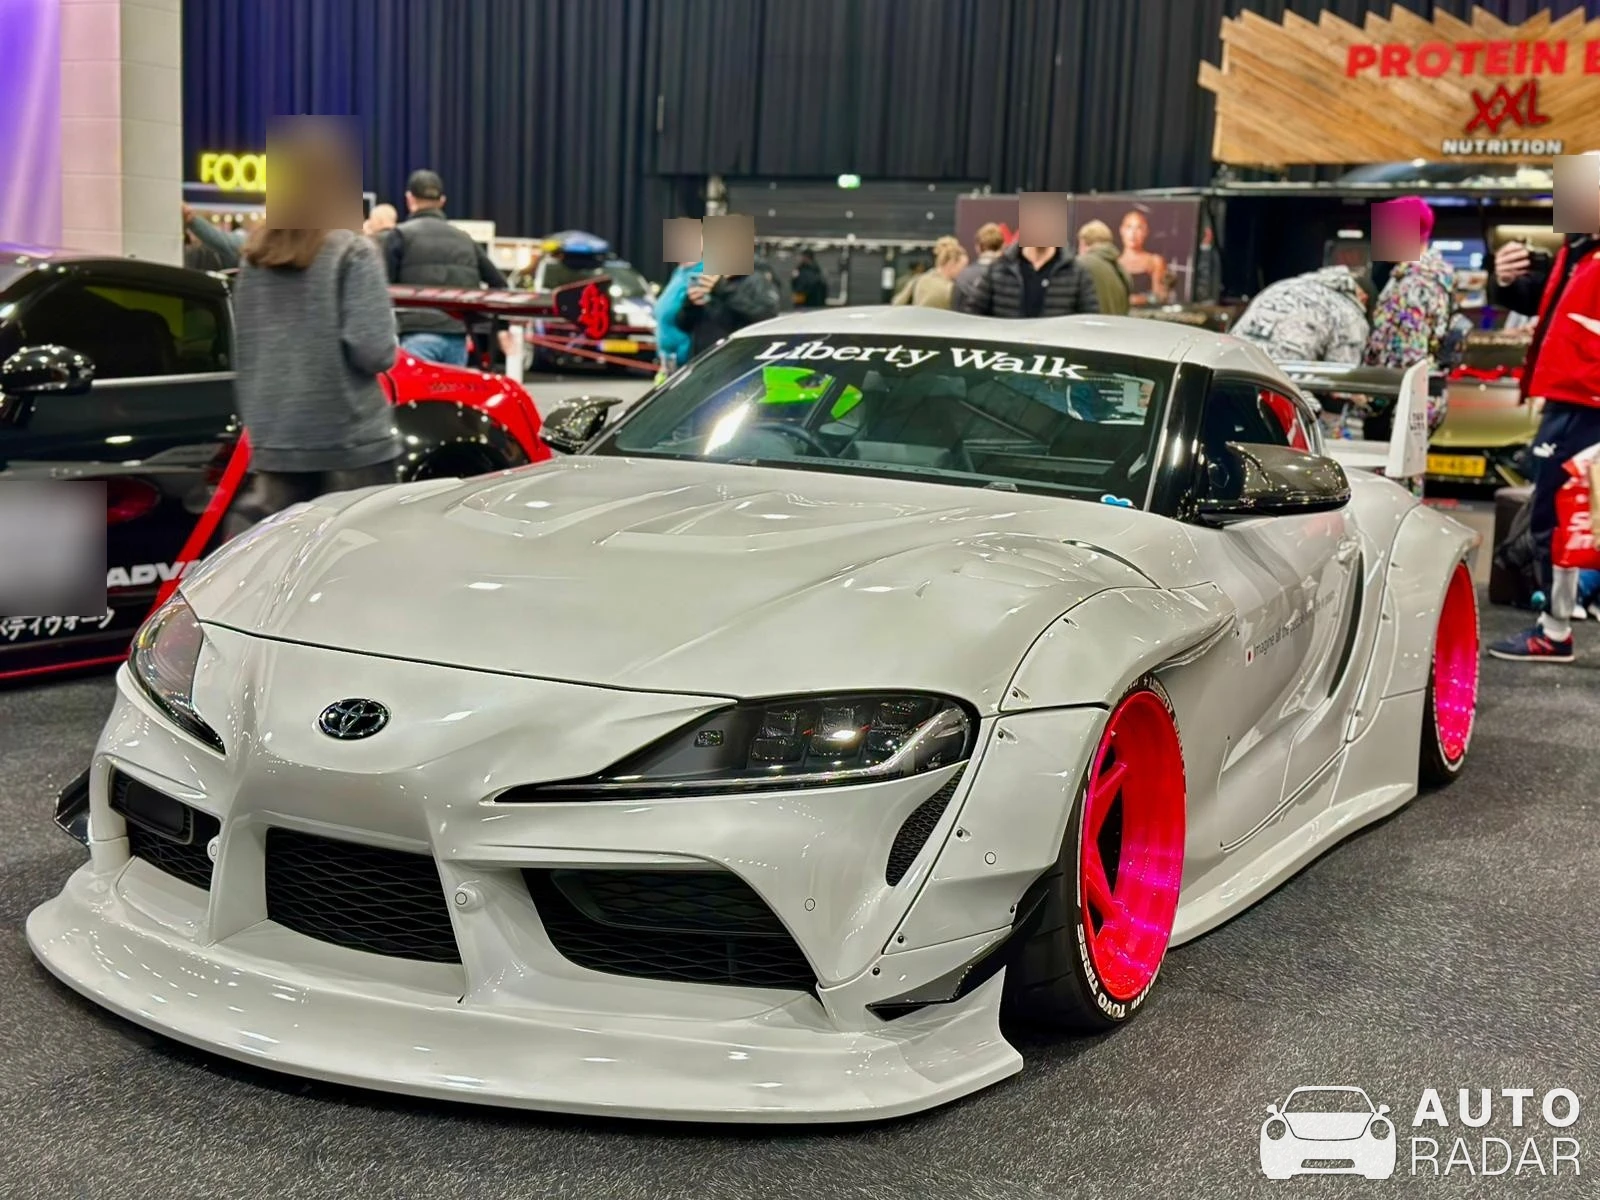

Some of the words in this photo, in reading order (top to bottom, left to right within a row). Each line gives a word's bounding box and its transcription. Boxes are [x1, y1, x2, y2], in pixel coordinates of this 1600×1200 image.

[1346, 38, 1568, 79] PROTEIN
[1465, 78, 1552, 135] XXL
[1442, 138, 1563, 155] NUTRITION
[754, 340, 940, 369] Liberty
[950, 347, 1089, 381] Walk
[1076, 923, 1099, 996] TIRES
[1097, 991, 1126, 1019] TOYO
